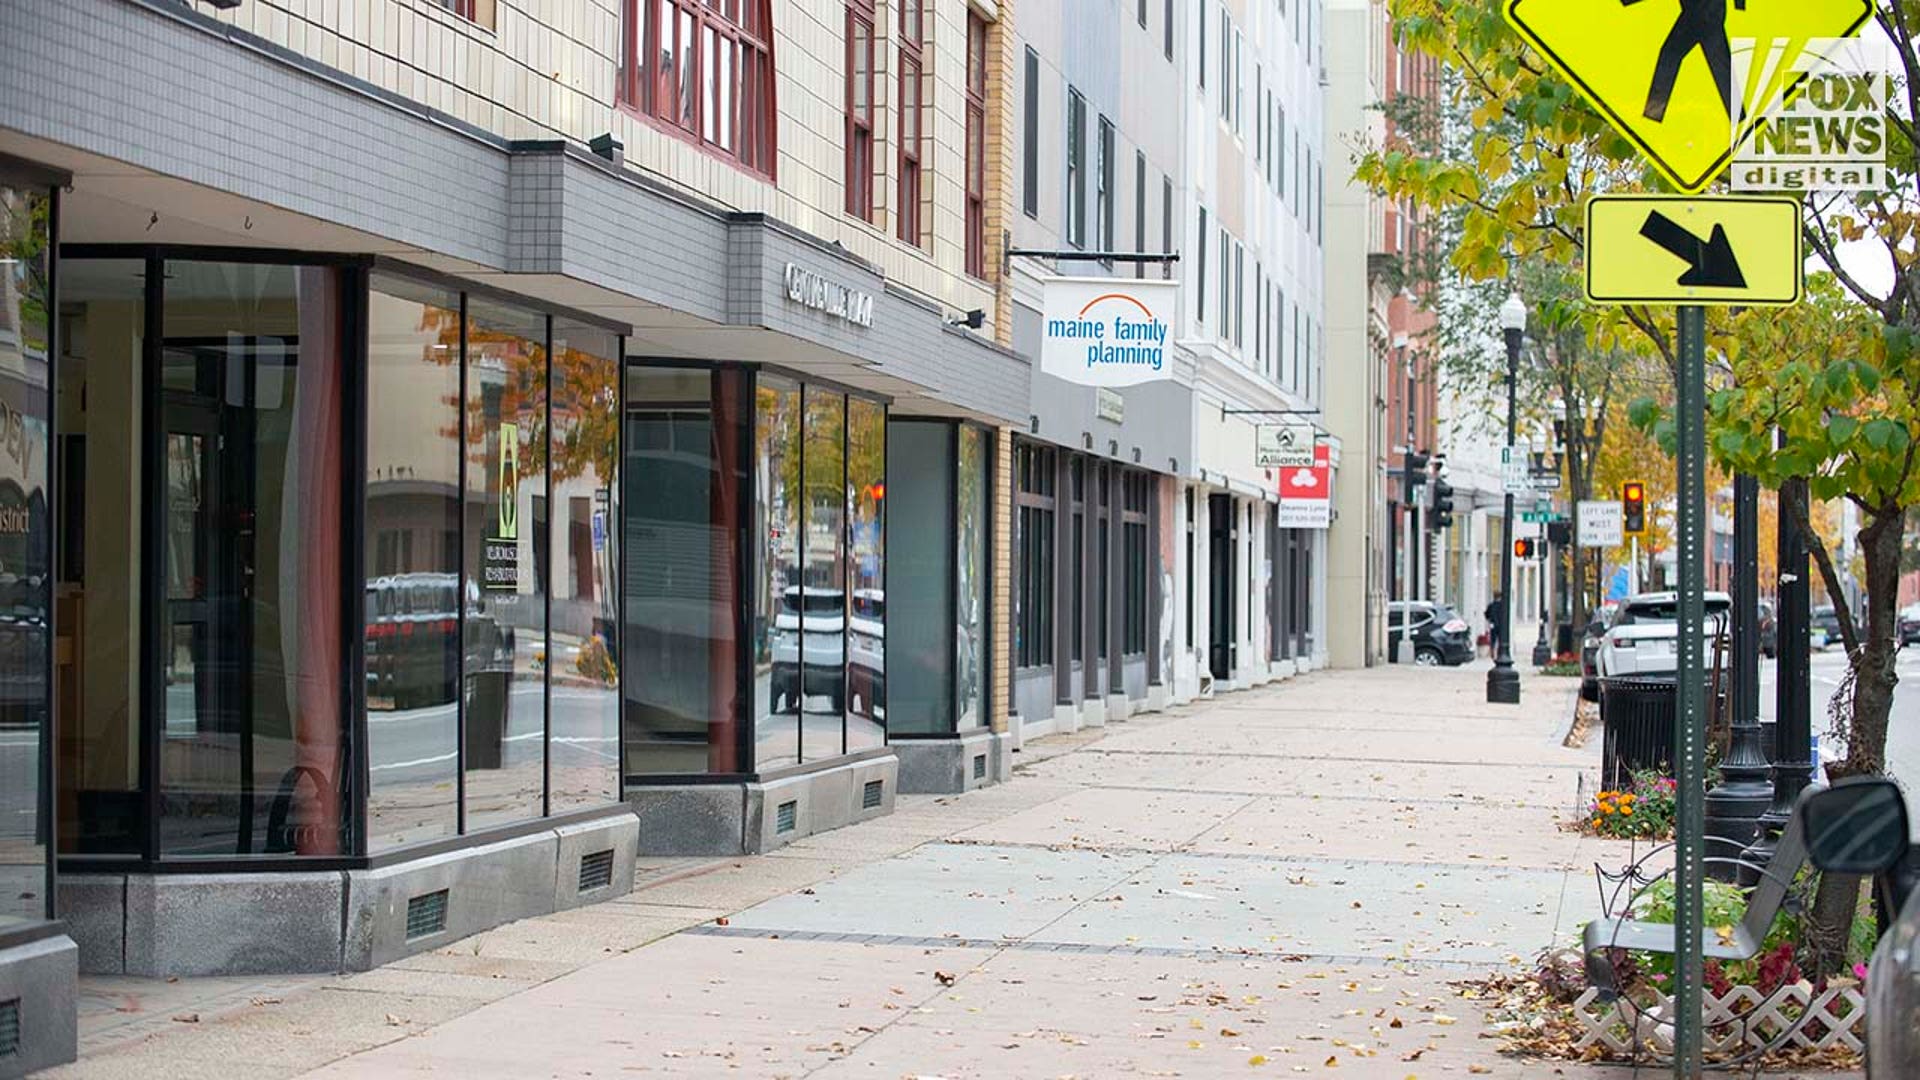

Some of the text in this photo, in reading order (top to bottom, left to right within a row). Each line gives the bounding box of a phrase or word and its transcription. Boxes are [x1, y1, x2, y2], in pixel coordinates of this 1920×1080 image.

[1048, 316, 1168, 347] maine family
[1087, 340, 1163, 371] planning
[1259, 455, 1312, 465] Alliance
[1588, 521, 1612, 529] MUST
